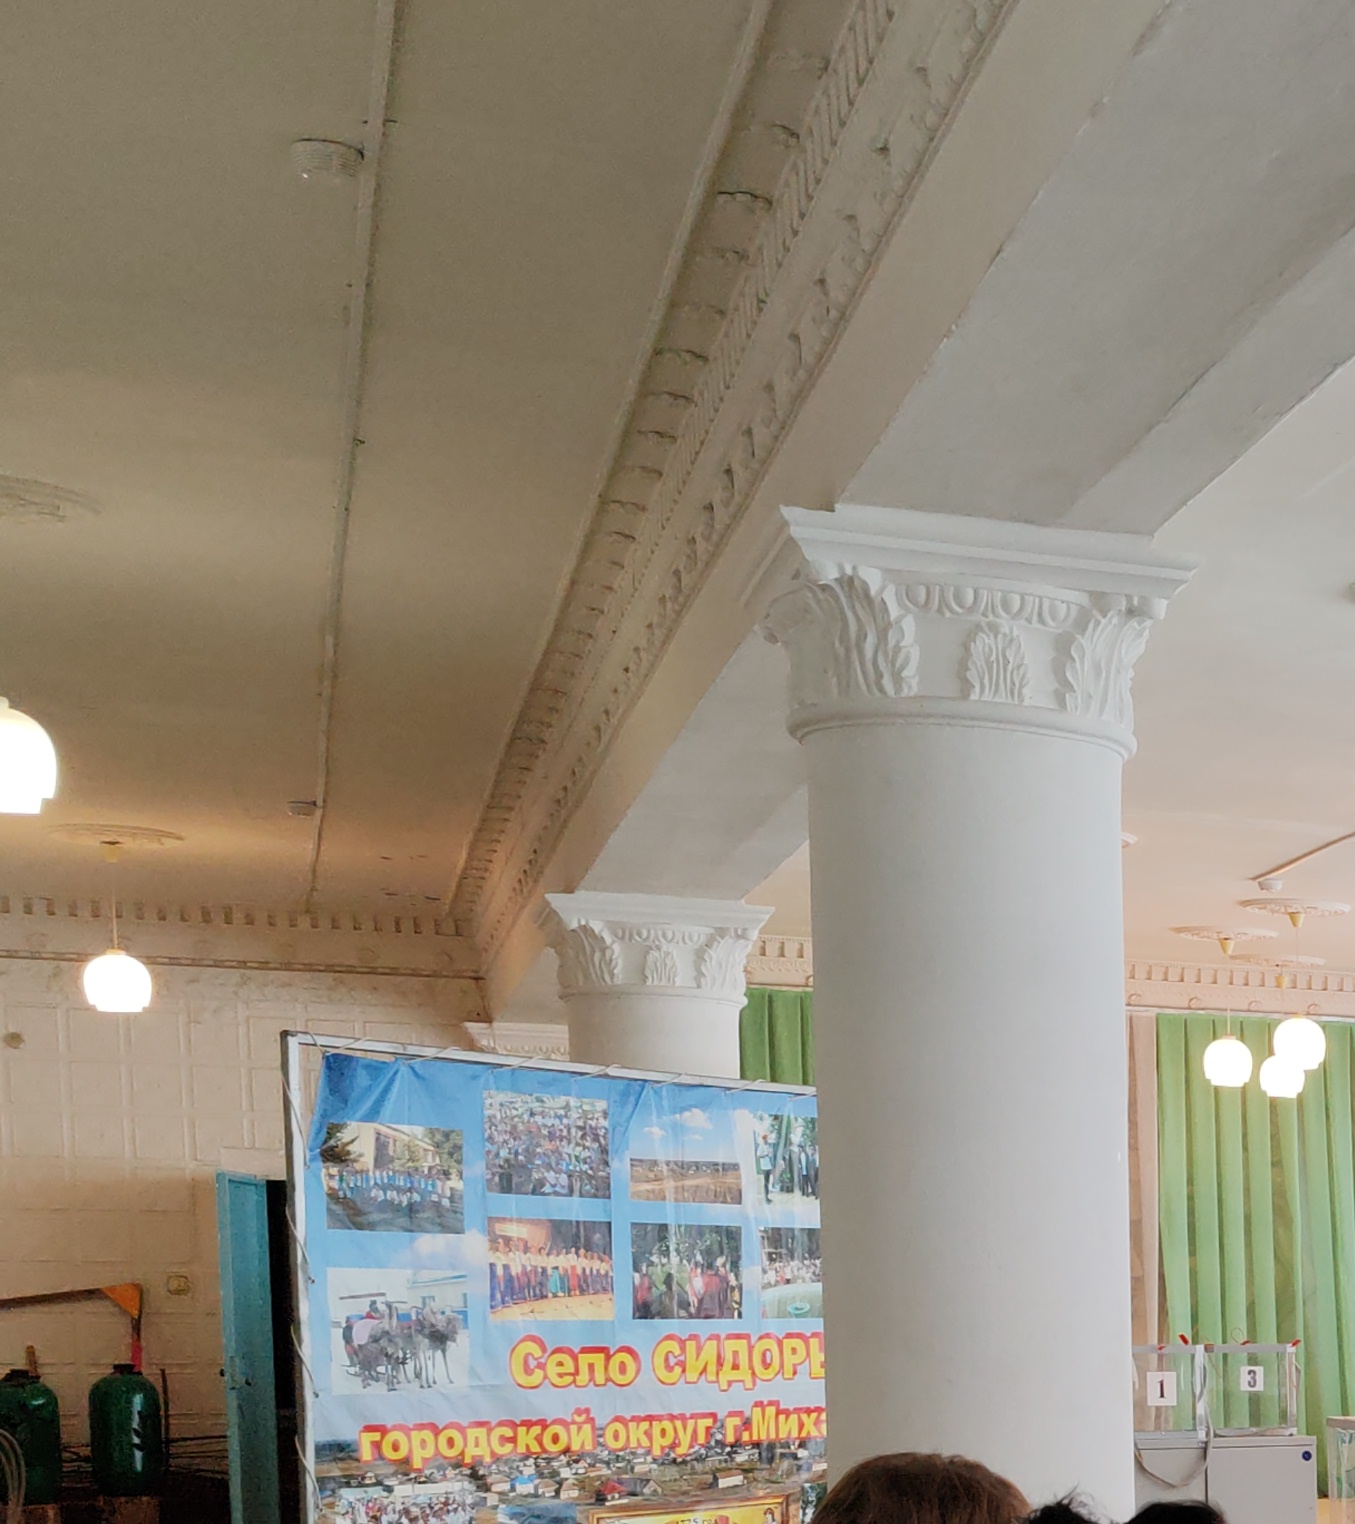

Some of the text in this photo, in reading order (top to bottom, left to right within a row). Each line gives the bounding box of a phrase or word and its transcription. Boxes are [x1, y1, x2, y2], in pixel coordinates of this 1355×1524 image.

[510, 1334, 641, 1389] Село
[1247, 1370, 1257, 1388] 3
[1156, 1379, 1166, 1398] 1
[359, 1407, 596, 1471] городской
[604, 1411, 718, 1458] округ
